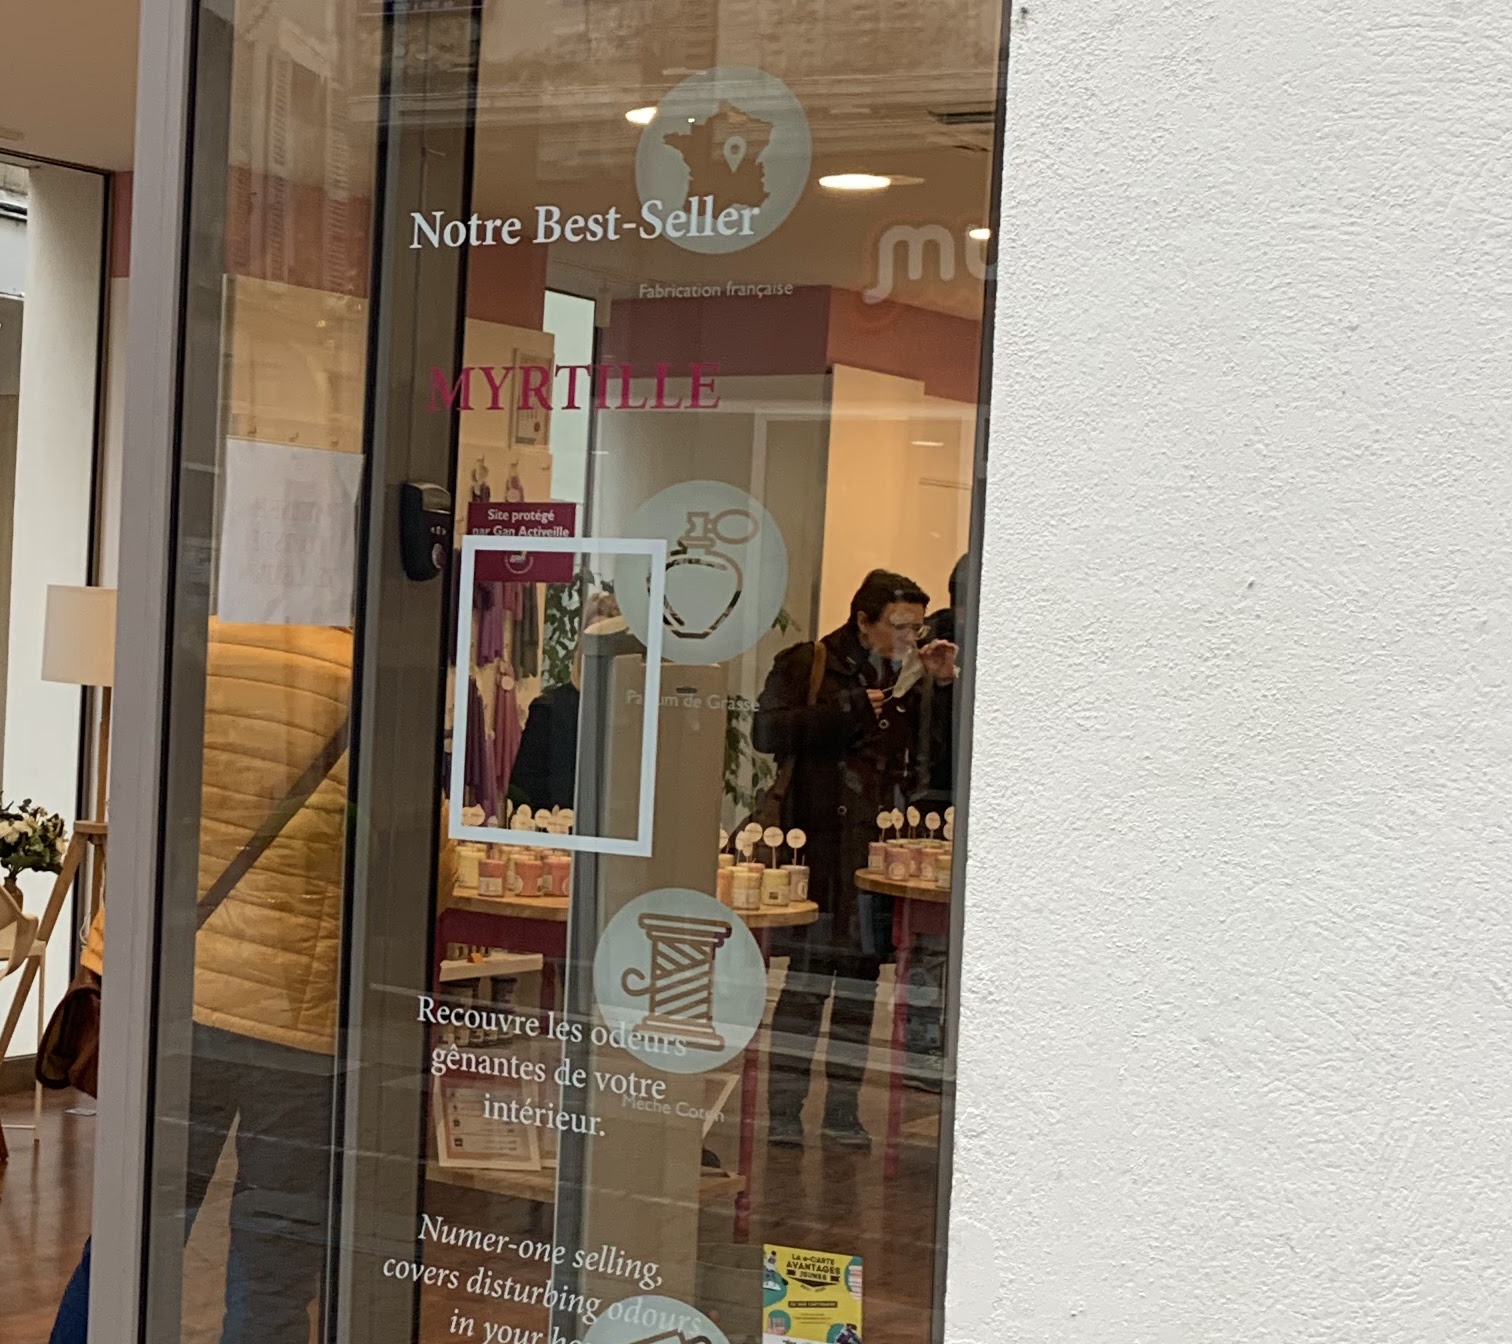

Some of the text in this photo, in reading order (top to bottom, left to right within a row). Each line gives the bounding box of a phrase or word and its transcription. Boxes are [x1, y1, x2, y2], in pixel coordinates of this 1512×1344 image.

[409, 196, 761, 250] Notre Best-Seller
[639, 281, 794, 299] Fabrication française
[425, 360, 723, 413] MYRTILLE
[487, 508, 555, 524] Site protégé
[492, 525, 516, 537] Gan
[626, 689, 761, 712] Paum de Grasse
[416, 995, 687, 1057] Recouvre les odeurs
[430, 1044, 667, 1100] gênantes de votre
[482, 1093, 606, 1137] intérieur.
[417, 1213, 663, 1291] Numer-one selling,
[786, 1261, 841, 1276] AVANTAGES
[382, 1257, 703, 1336] covers disturbing odours
[449, 1308, 474, 1337] in
